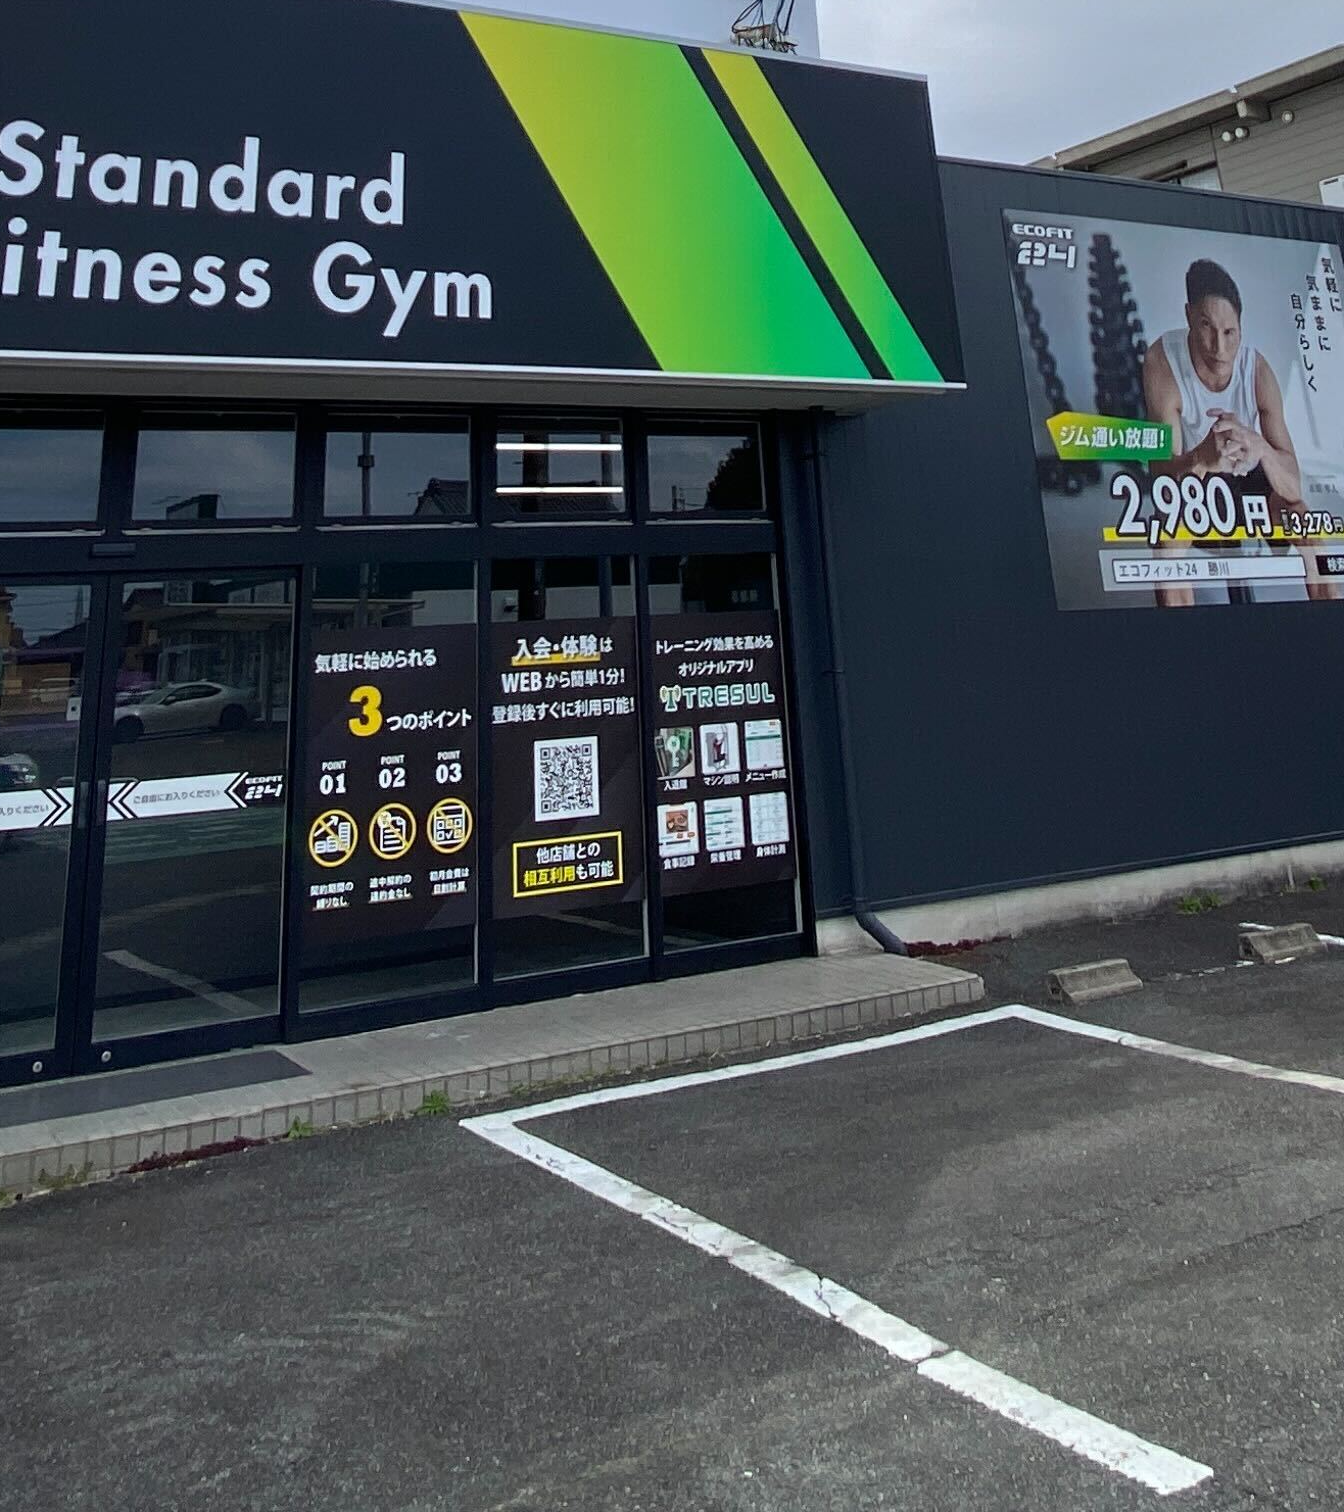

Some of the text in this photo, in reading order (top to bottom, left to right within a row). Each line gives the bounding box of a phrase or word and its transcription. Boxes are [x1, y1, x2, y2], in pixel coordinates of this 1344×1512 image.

[1012, 223, 1073, 240] ECOFIT
[1017, 241, 1076, 268] 24
[312, 241, 494, 338] Gym
[1321, 257, 1342, 312] 気軽に
[1306, 275, 1331, 351] 気ままに
[1290, 293, 1317, 392] 自分らしく
[315, 648, 437, 673] 気軽に始められる
[678, 658, 754, 676] オリジナルアプリ
[322, 760, 346, 771] POINT
[381, 754, 404, 765] POINT
[437, 750, 461, 760] POINT
[379, 767, 406, 788] 02
[436, 763, 462, 783] 03
[319, 773, 346, 795] 01
